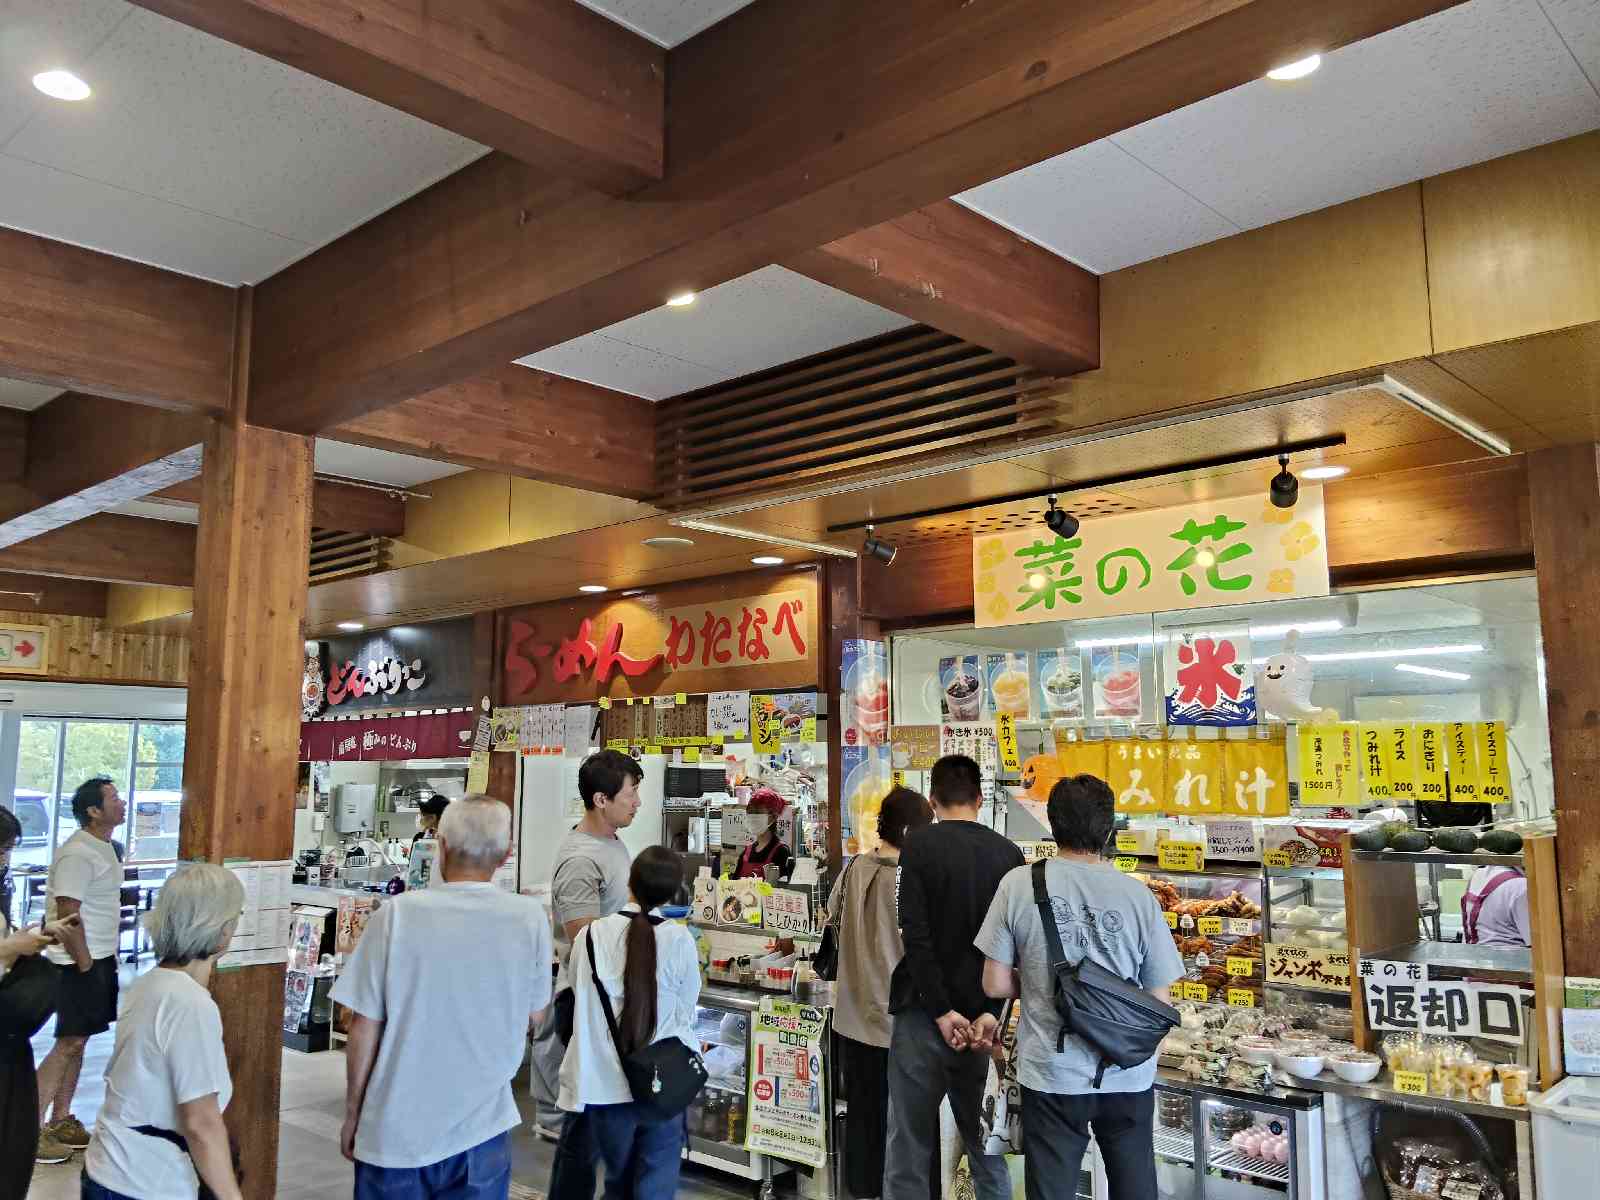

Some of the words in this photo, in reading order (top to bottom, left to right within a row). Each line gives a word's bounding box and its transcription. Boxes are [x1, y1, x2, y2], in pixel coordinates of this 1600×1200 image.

[1014, 514, 1254, 612] 菜の花
[665, 599, 806, 674] わたなべ
[1177, 637, 1243, 711] 氷
[1001, 714, 1014, 755] 氷カフェ
[1366, 730, 1383, 777] つみれ汁
[1394, 729, 1406, 760] ライス
[1423, 729, 1436, 772] おにぎり
[1455, 722, 1466, 776] アイスティー
[1486, 722, 1500, 784] アイスコーヒー
[1360, 961, 1421, 980] 菜の花
[1371, 984, 1521, 1037] 返却口
